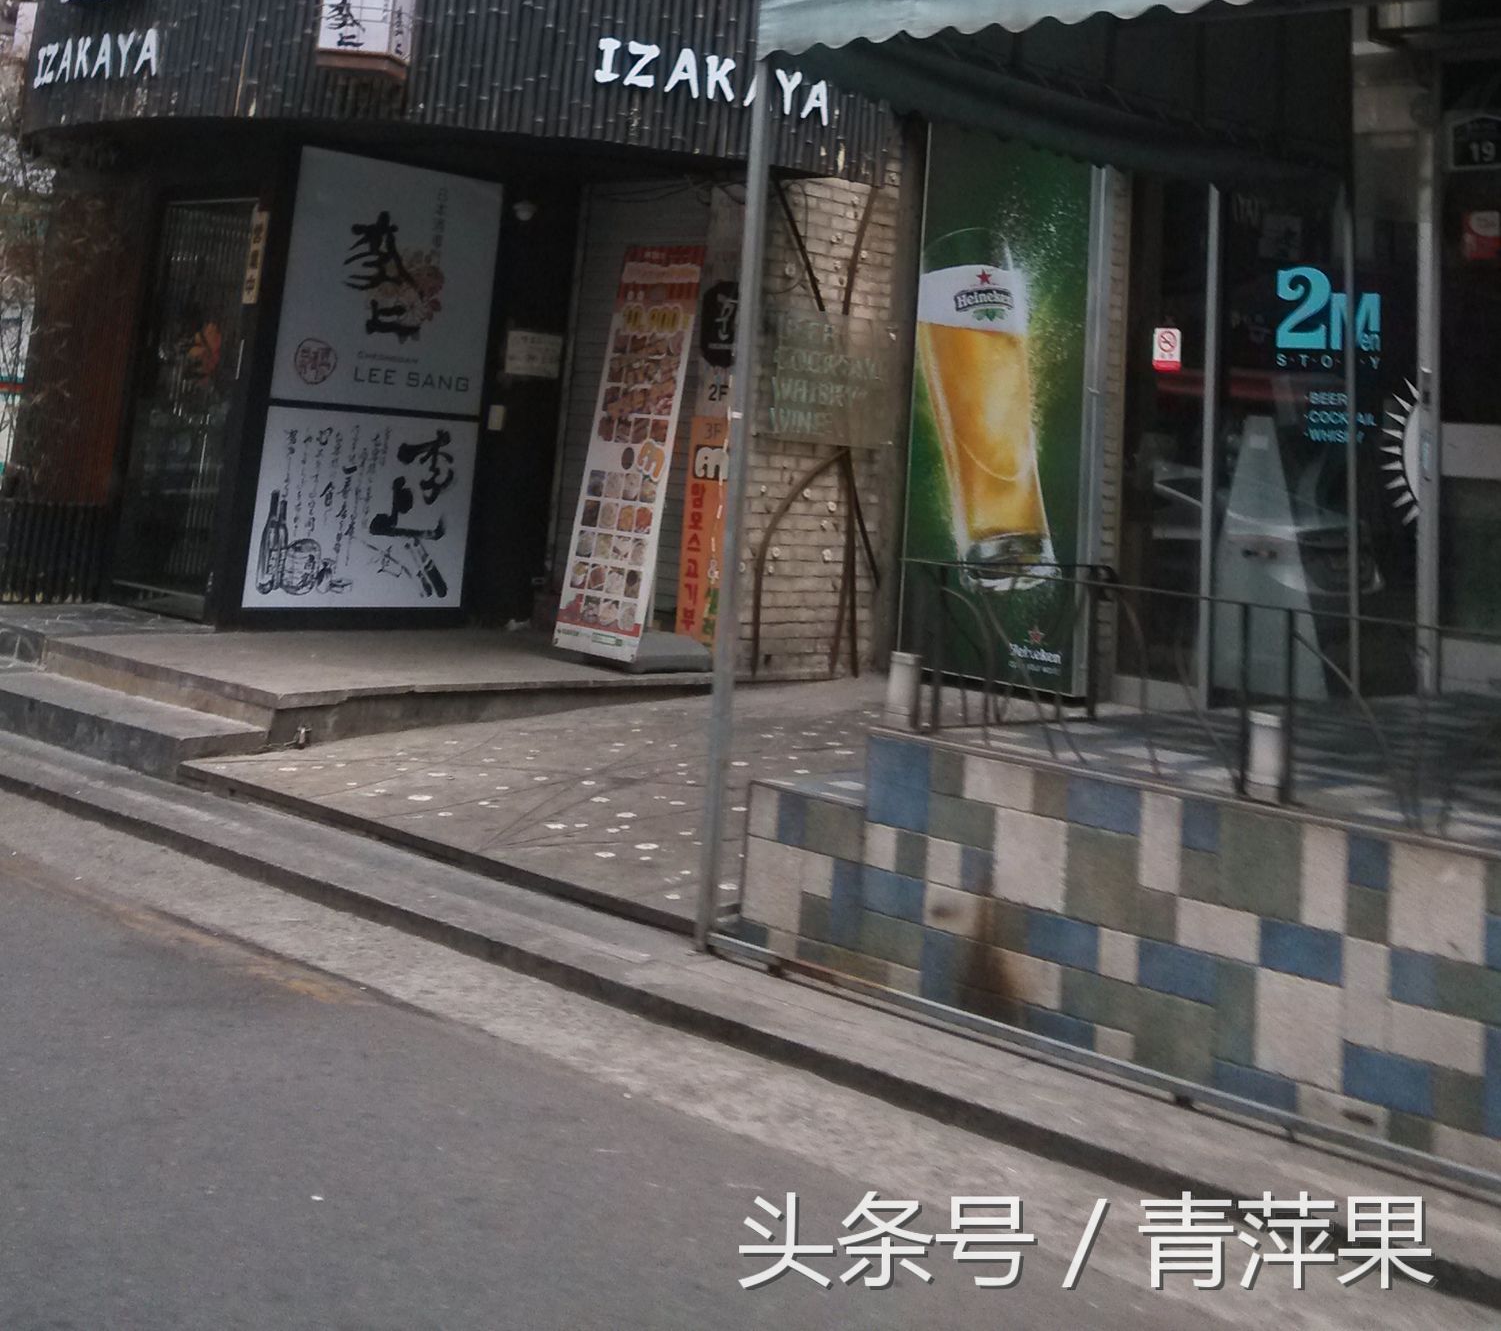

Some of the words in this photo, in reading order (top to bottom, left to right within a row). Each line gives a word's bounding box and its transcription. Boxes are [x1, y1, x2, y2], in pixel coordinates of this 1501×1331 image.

[33, 28, 160, 90] IZAKAYA
[1469, 140, 1496, 163] 19
[956, 290, 1014, 310] Heineken
[353, 366, 398, 386] LEE
[405, 371, 470, 393] SANG
[708, 384, 729, 402] 2F
[1308, 410, 1377, 427] COCKAIL
